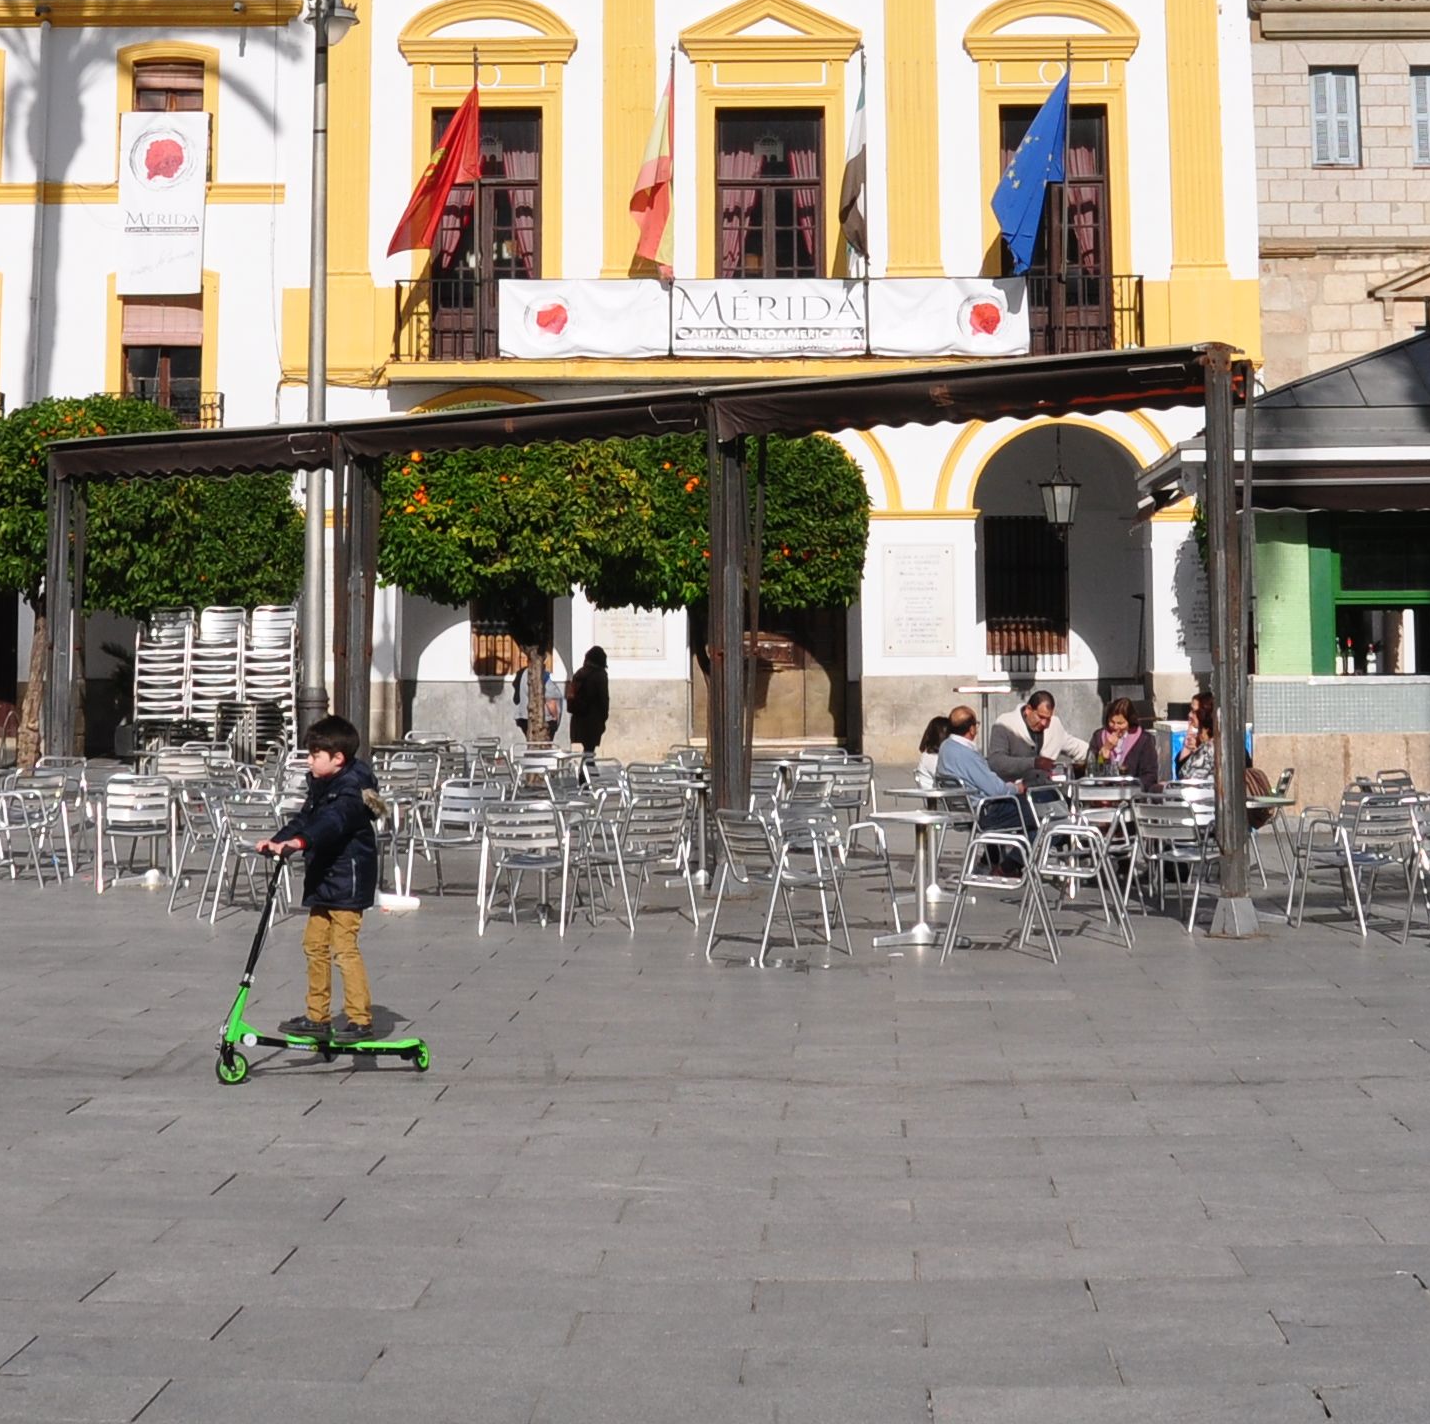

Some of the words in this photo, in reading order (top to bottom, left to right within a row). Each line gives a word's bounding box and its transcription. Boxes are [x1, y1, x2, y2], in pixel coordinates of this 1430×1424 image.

[675, 286, 861, 327] MÉRIDA
[677, 328, 737, 340] CAPITAL
[738, 328, 864, 340] IBEROAMERICANA
